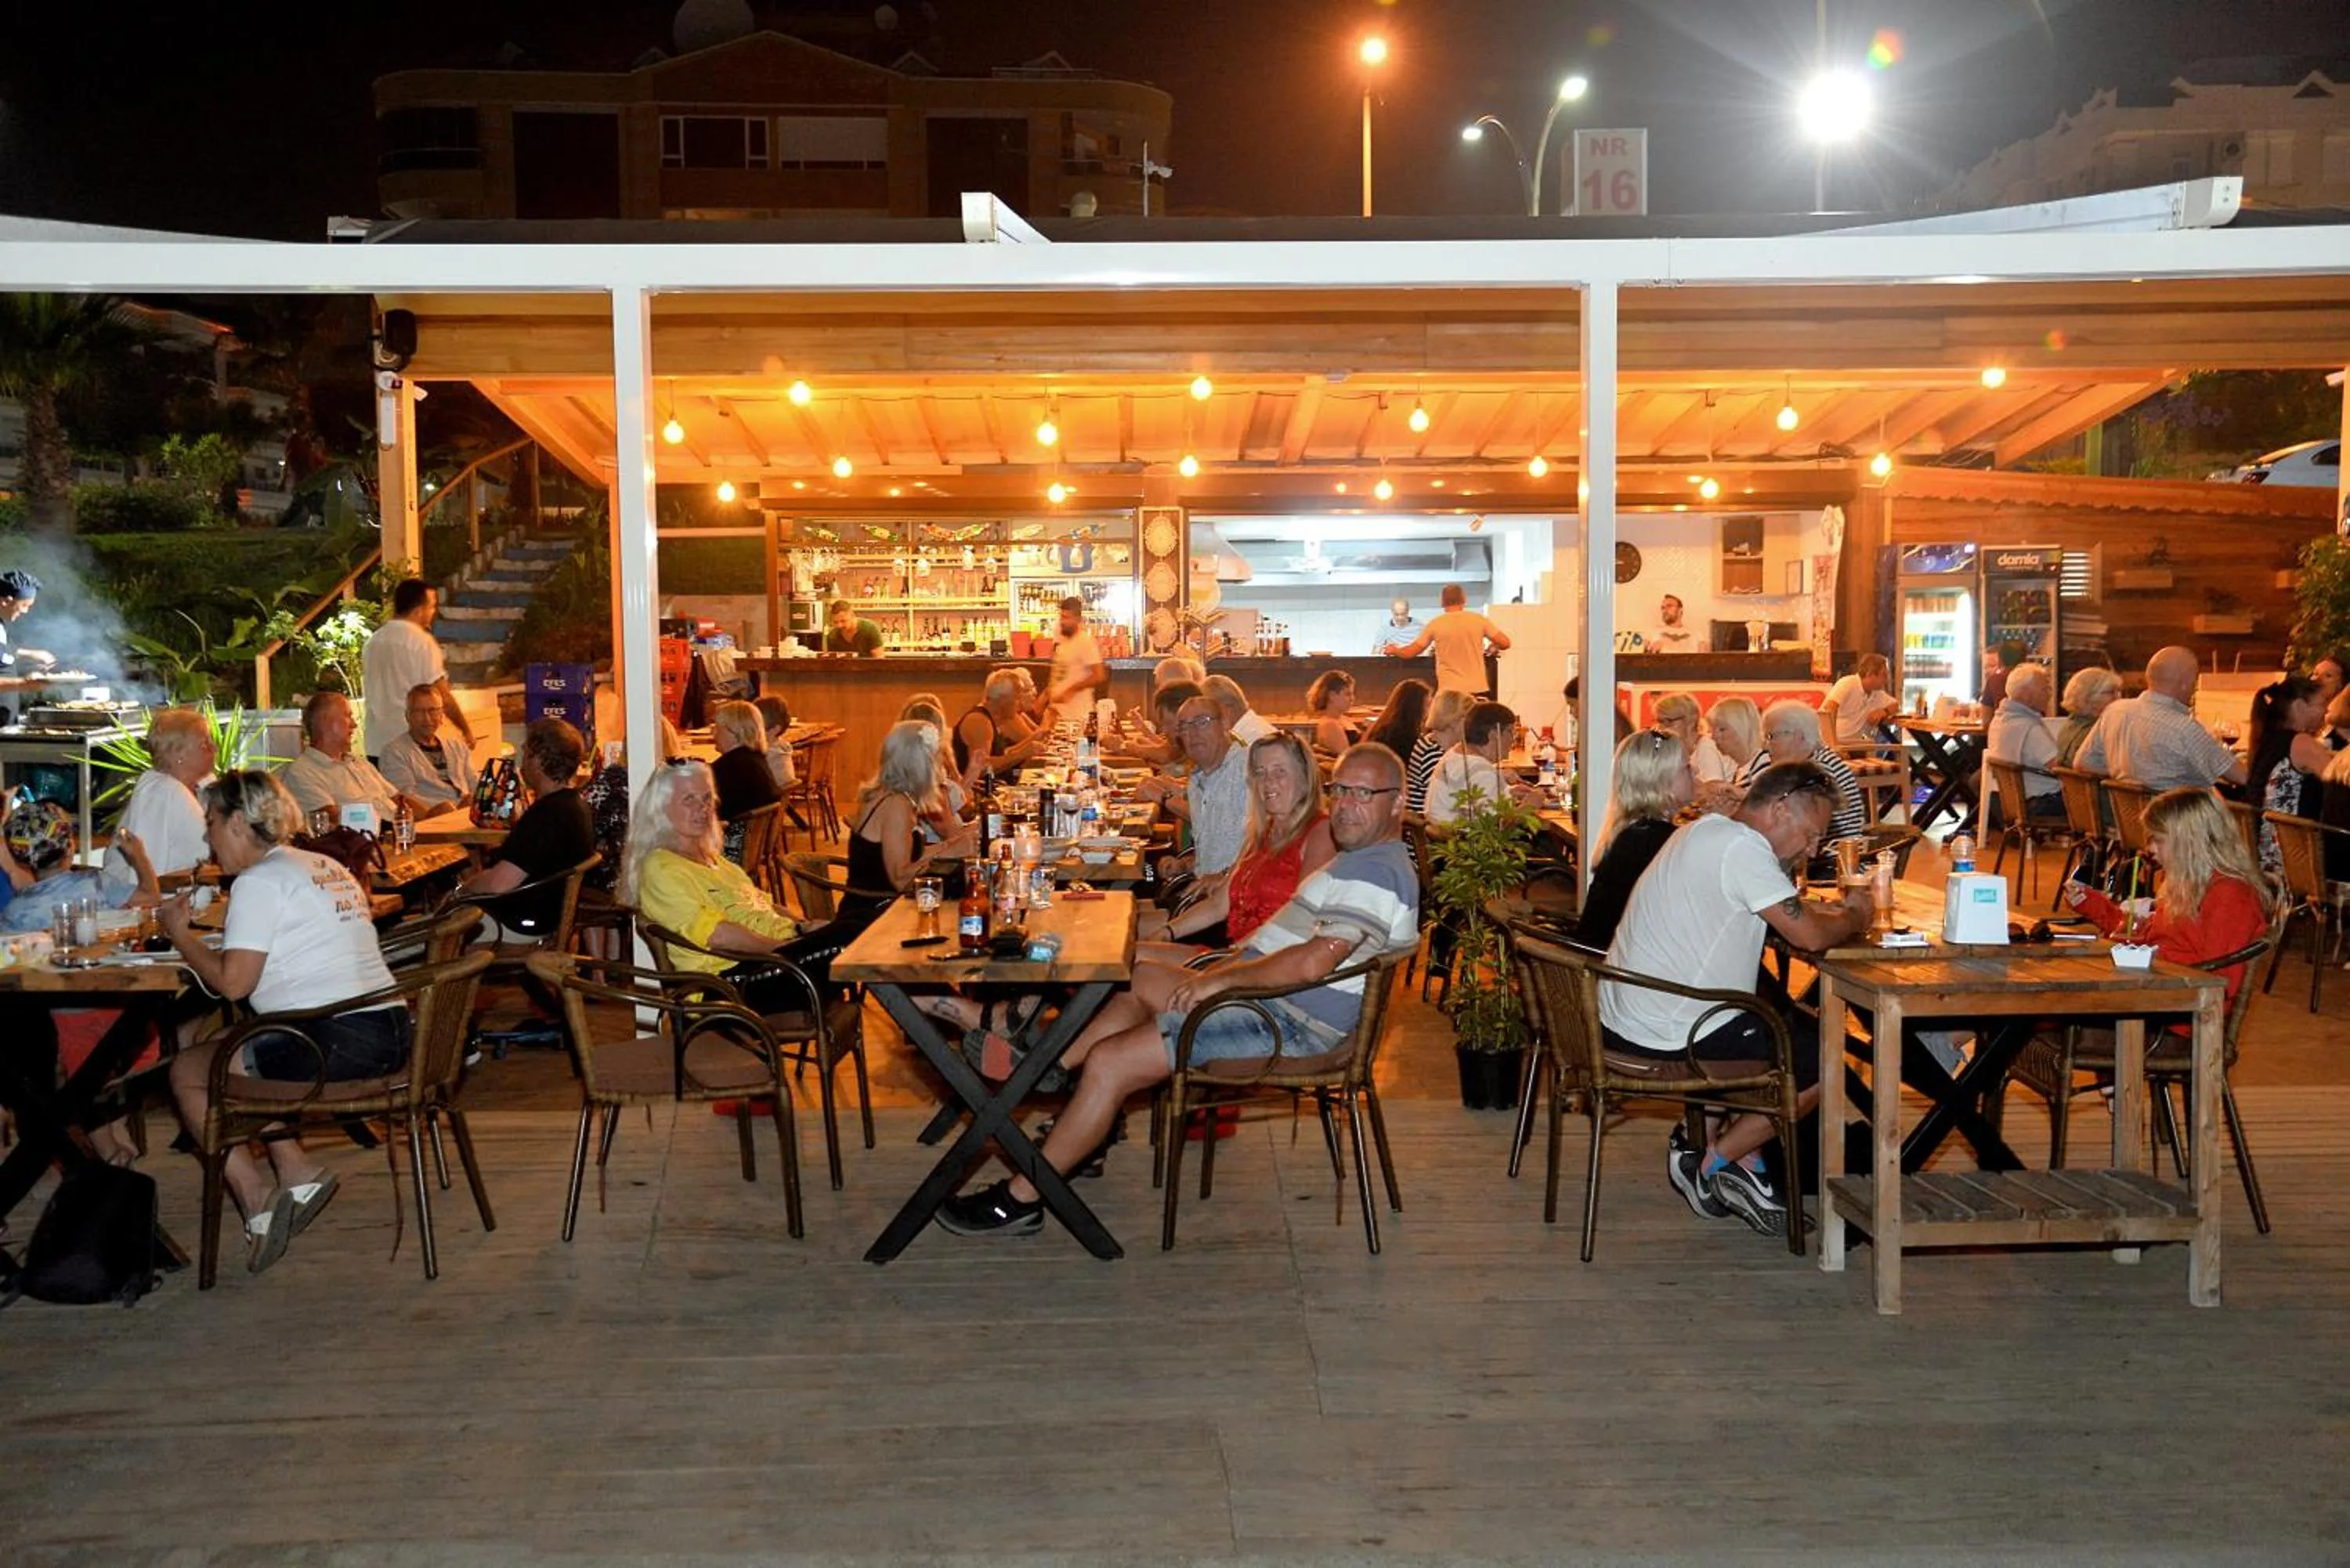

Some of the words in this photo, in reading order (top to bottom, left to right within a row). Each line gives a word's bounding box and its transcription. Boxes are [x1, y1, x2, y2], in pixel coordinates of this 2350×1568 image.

[1590, 137, 1628, 156] NR
[1582, 168, 1638, 211] 16
[1998, 552, 2040, 565] damla
